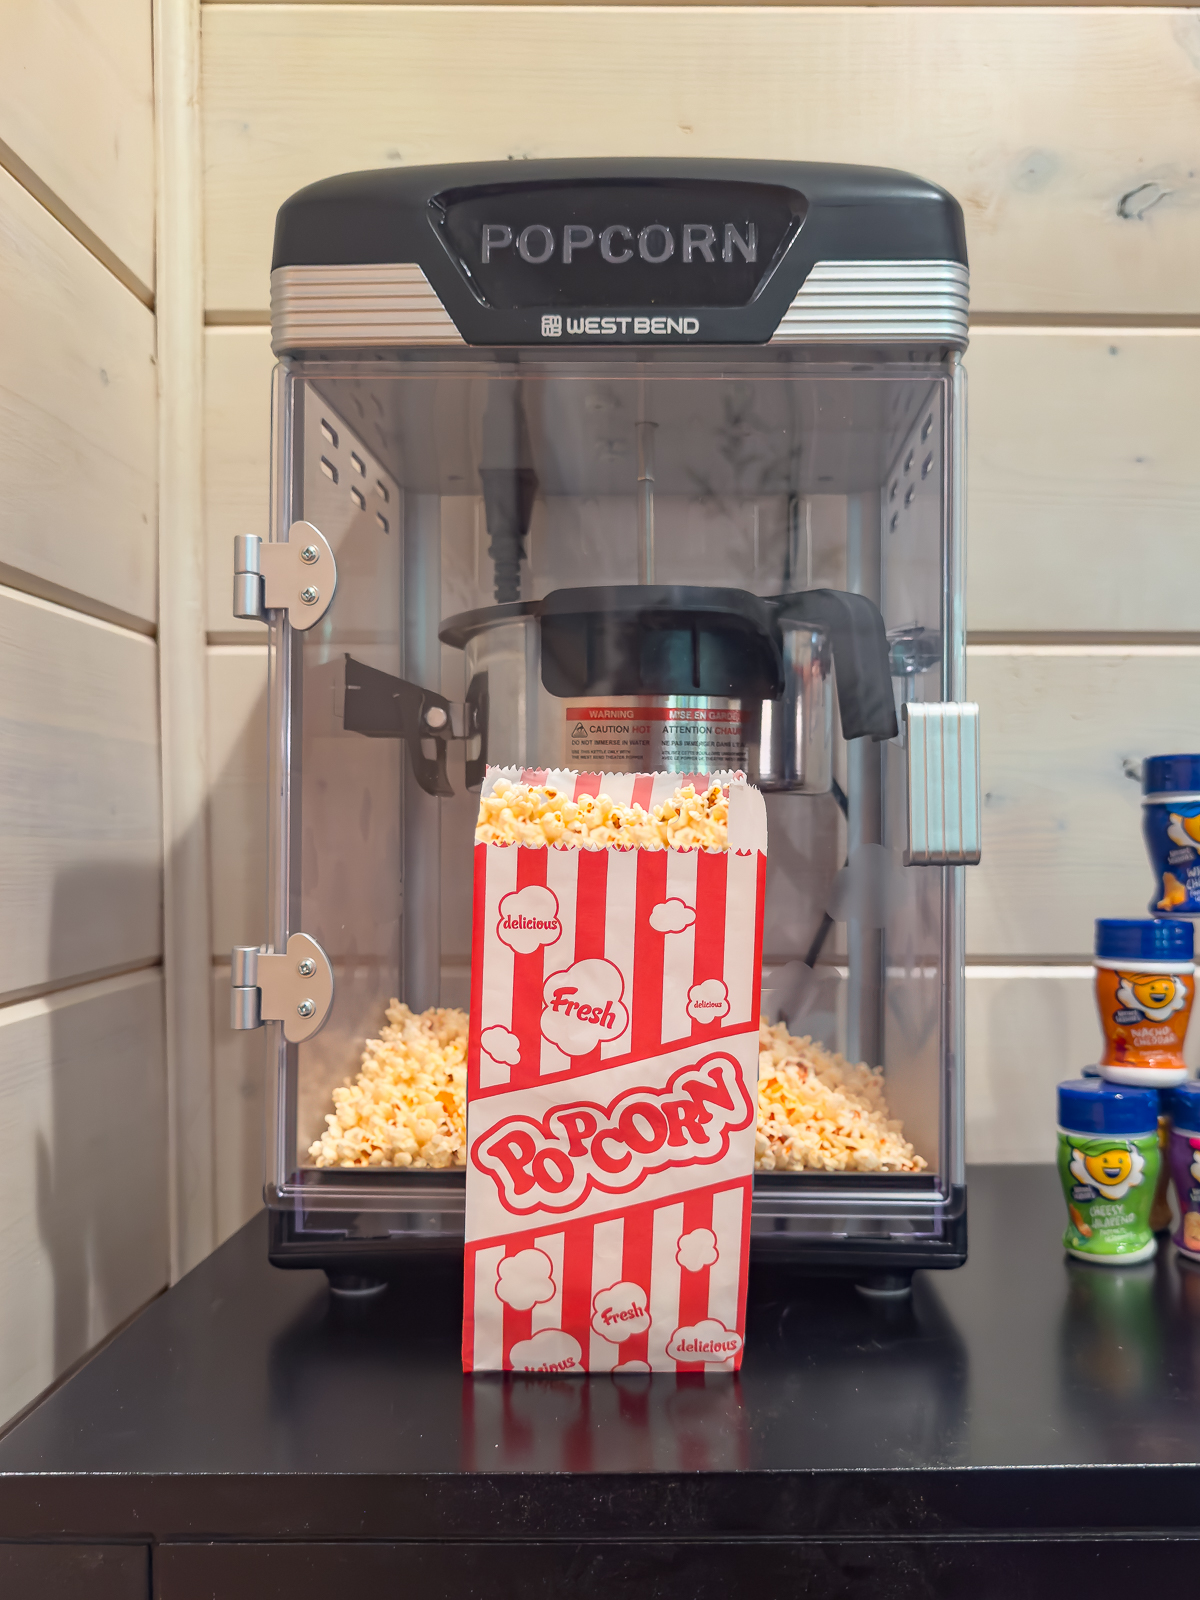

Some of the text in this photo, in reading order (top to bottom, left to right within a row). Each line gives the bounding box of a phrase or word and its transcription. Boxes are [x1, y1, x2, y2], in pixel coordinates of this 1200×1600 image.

[481, 222, 758, 264] POPCORN
[566, 317, 700, 335] WEST BEND
[589, 710, 635, 719] WARNING
[669, 710, 692, 720] MISE
[694, 710, 706, 720] EN
[589, 725, 651, 734] CAUTION HOT
[662, 725, 712, 735] ATTENTION
[503, 914, 558, 930] delicious
[550, 987, 616, 1029] Fresh
[693, 1000, 722, 1009] delicious
[487, 1066, 735, 1195] POPCORN
[601, 1301, 644, 1326] Fresh
[676, 1338, 738, 1353] delicious
